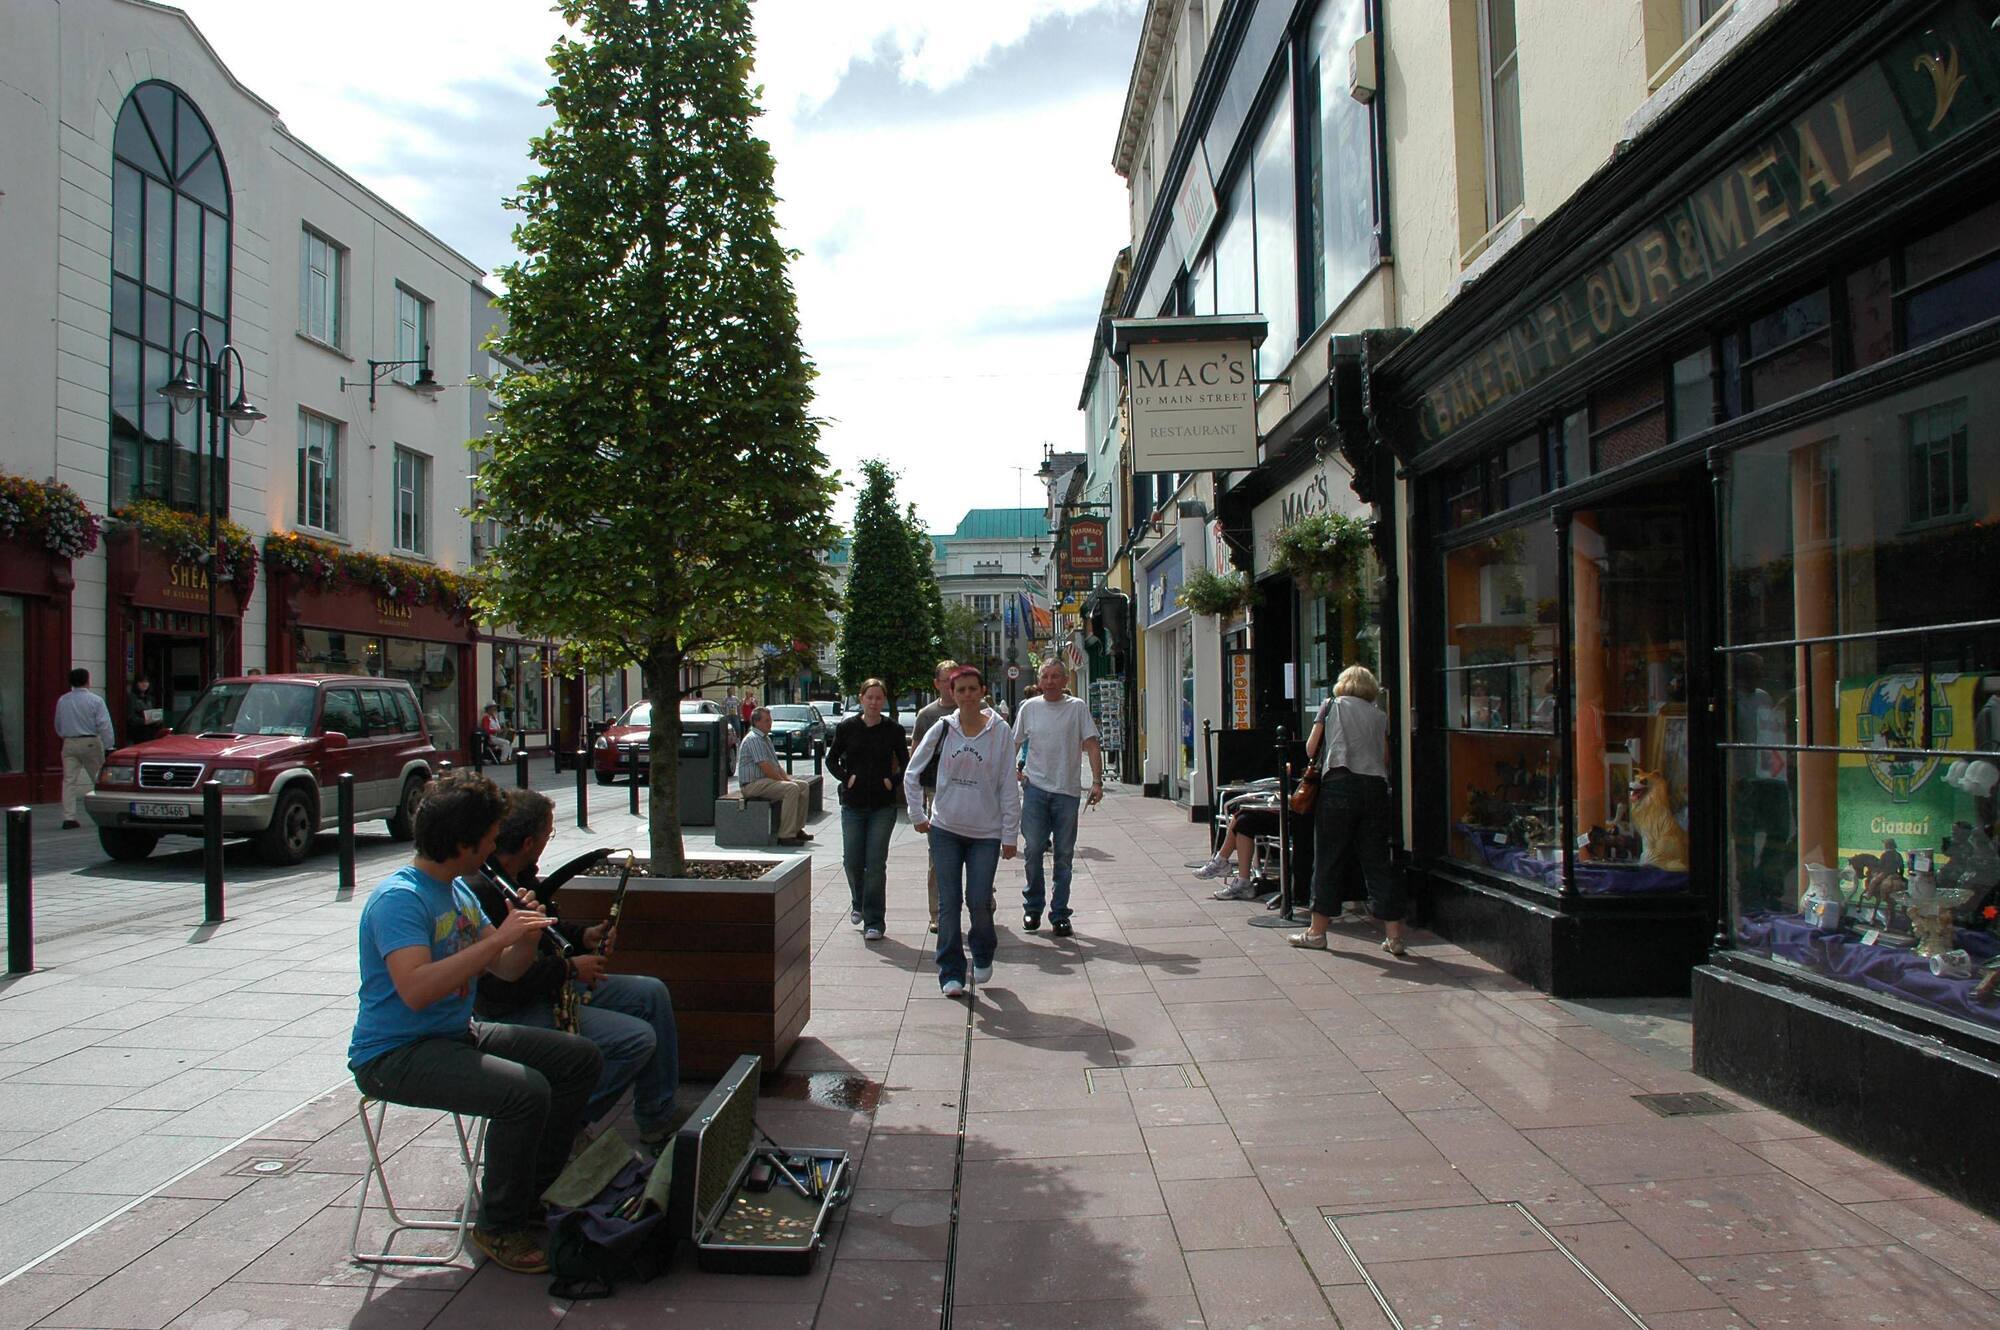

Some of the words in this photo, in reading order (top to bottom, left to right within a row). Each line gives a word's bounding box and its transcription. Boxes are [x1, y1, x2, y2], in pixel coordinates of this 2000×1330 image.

[1536, 233, 1680, 368] FLOUR
[1673, 217, 1699, 276] &
[1696, 100, 1893, 262] MEAL
[1135, 396, 1152, 406] OF
[1159, 394, 1193, 405] MAIN
[1199, 392, 1248, 403] STREET
[1150, 423, 1238, 439] RESTAURANT
